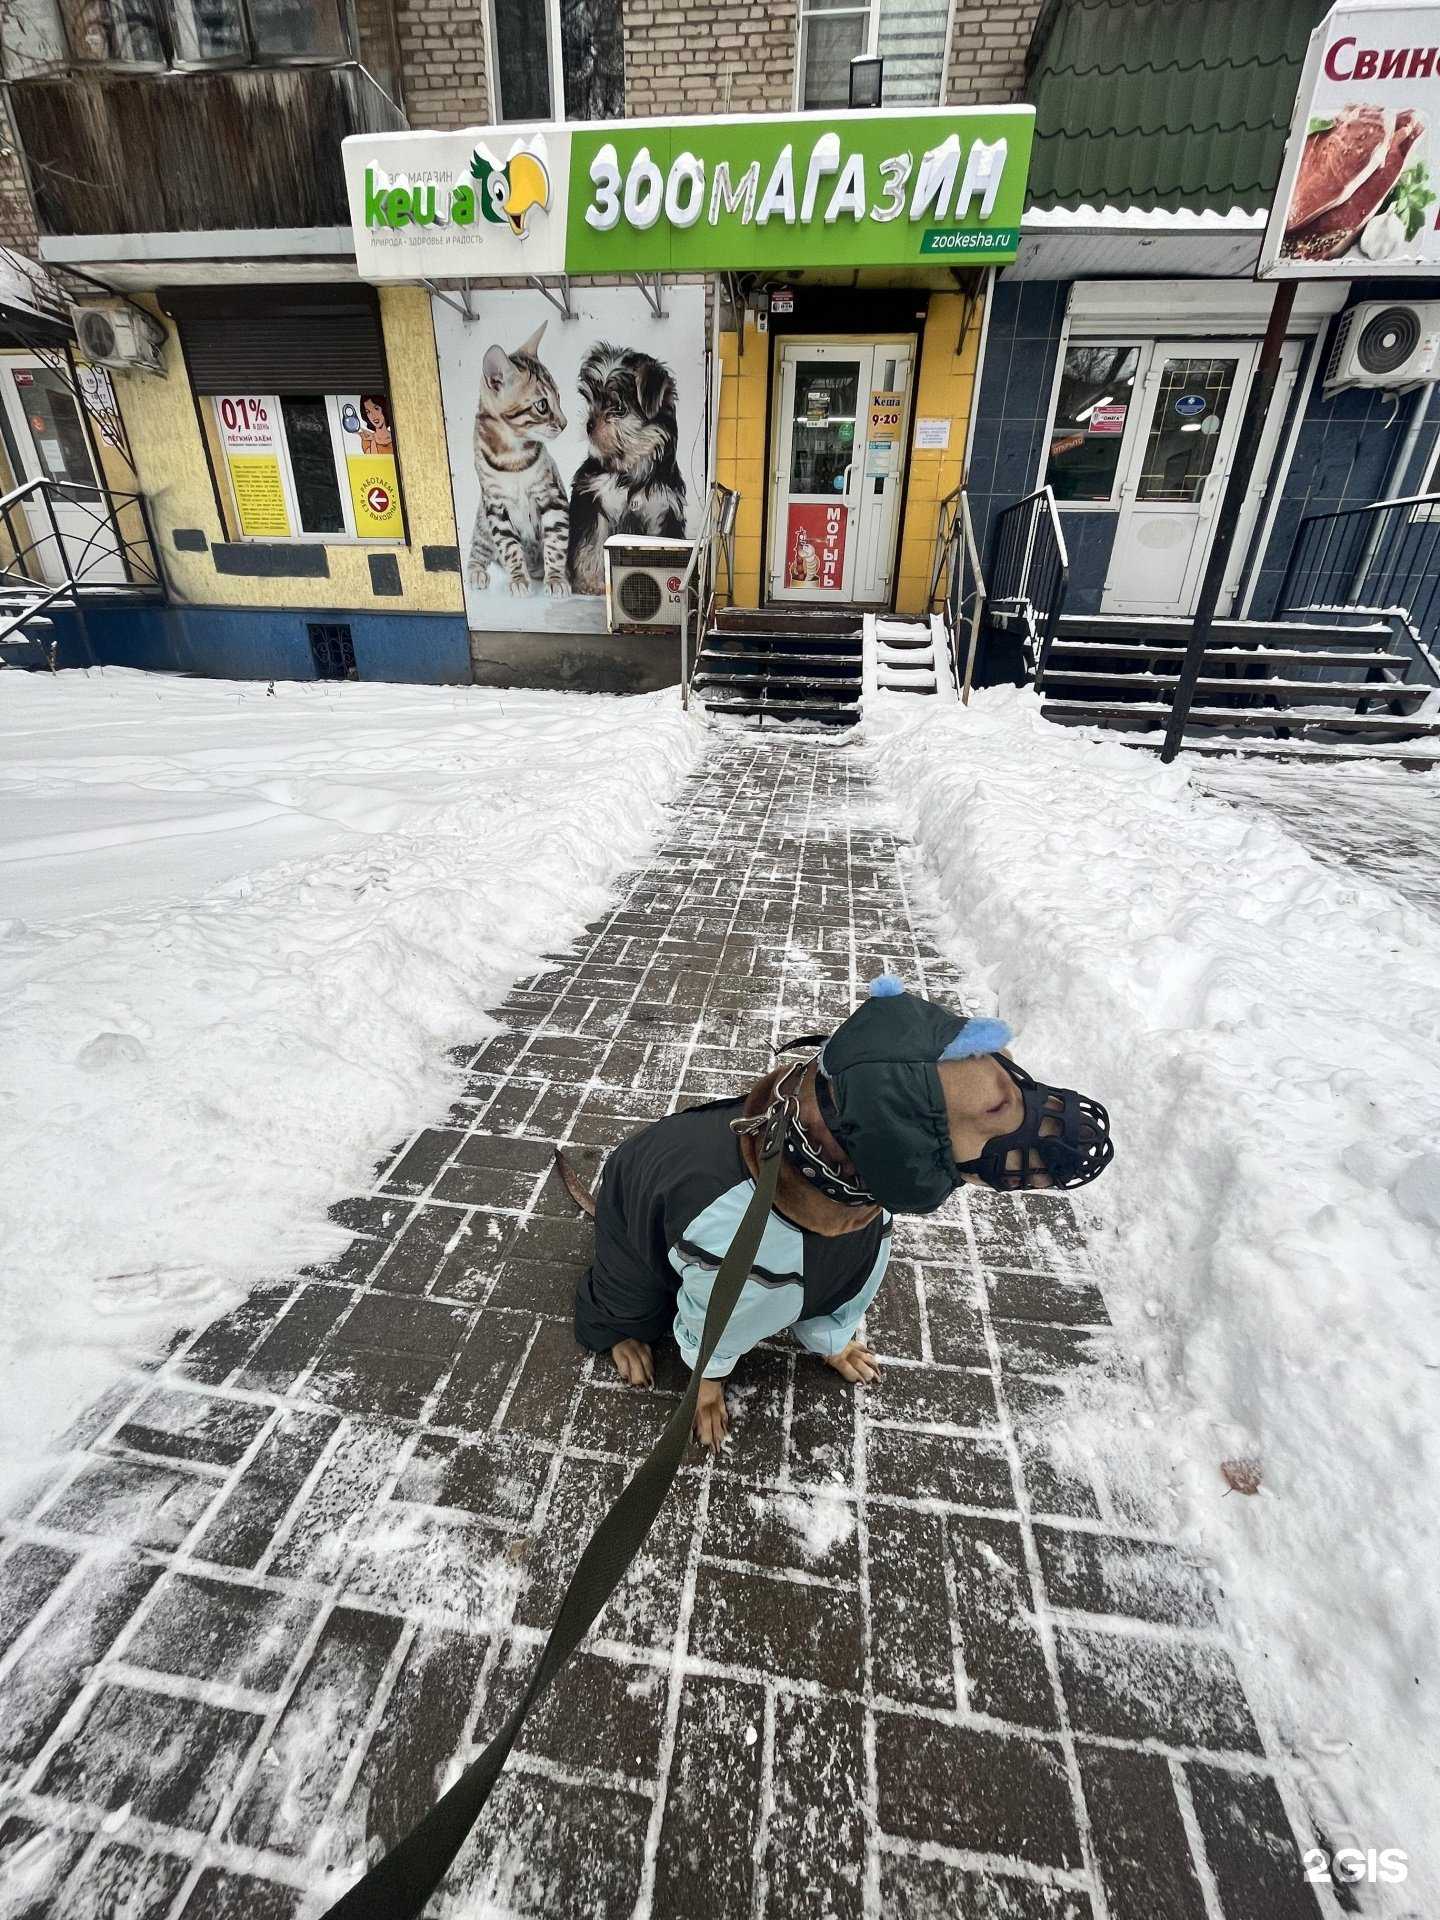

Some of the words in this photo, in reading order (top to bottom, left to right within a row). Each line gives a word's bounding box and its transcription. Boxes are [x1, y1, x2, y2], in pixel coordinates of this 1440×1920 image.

[1324, 36, 1440, 81] Свин
[584, 140, 1008, 231] ЗООМАГАЗИН
[371, 237, 403, 247] ПРИРОДА
[409, 235, 443, 247] ЗДОРОВЬЕ
[452, 234, 484, 245] РАДОСТЬ
[932, 231, 1011, 248] zookesha.ru
[873, 396, 900, 407] Кеша
[222, 398, 267, 432] 0,1%
[823, 508, 841, 587] МОТЫЛЬ
[668, 595, 680, 603] LG
